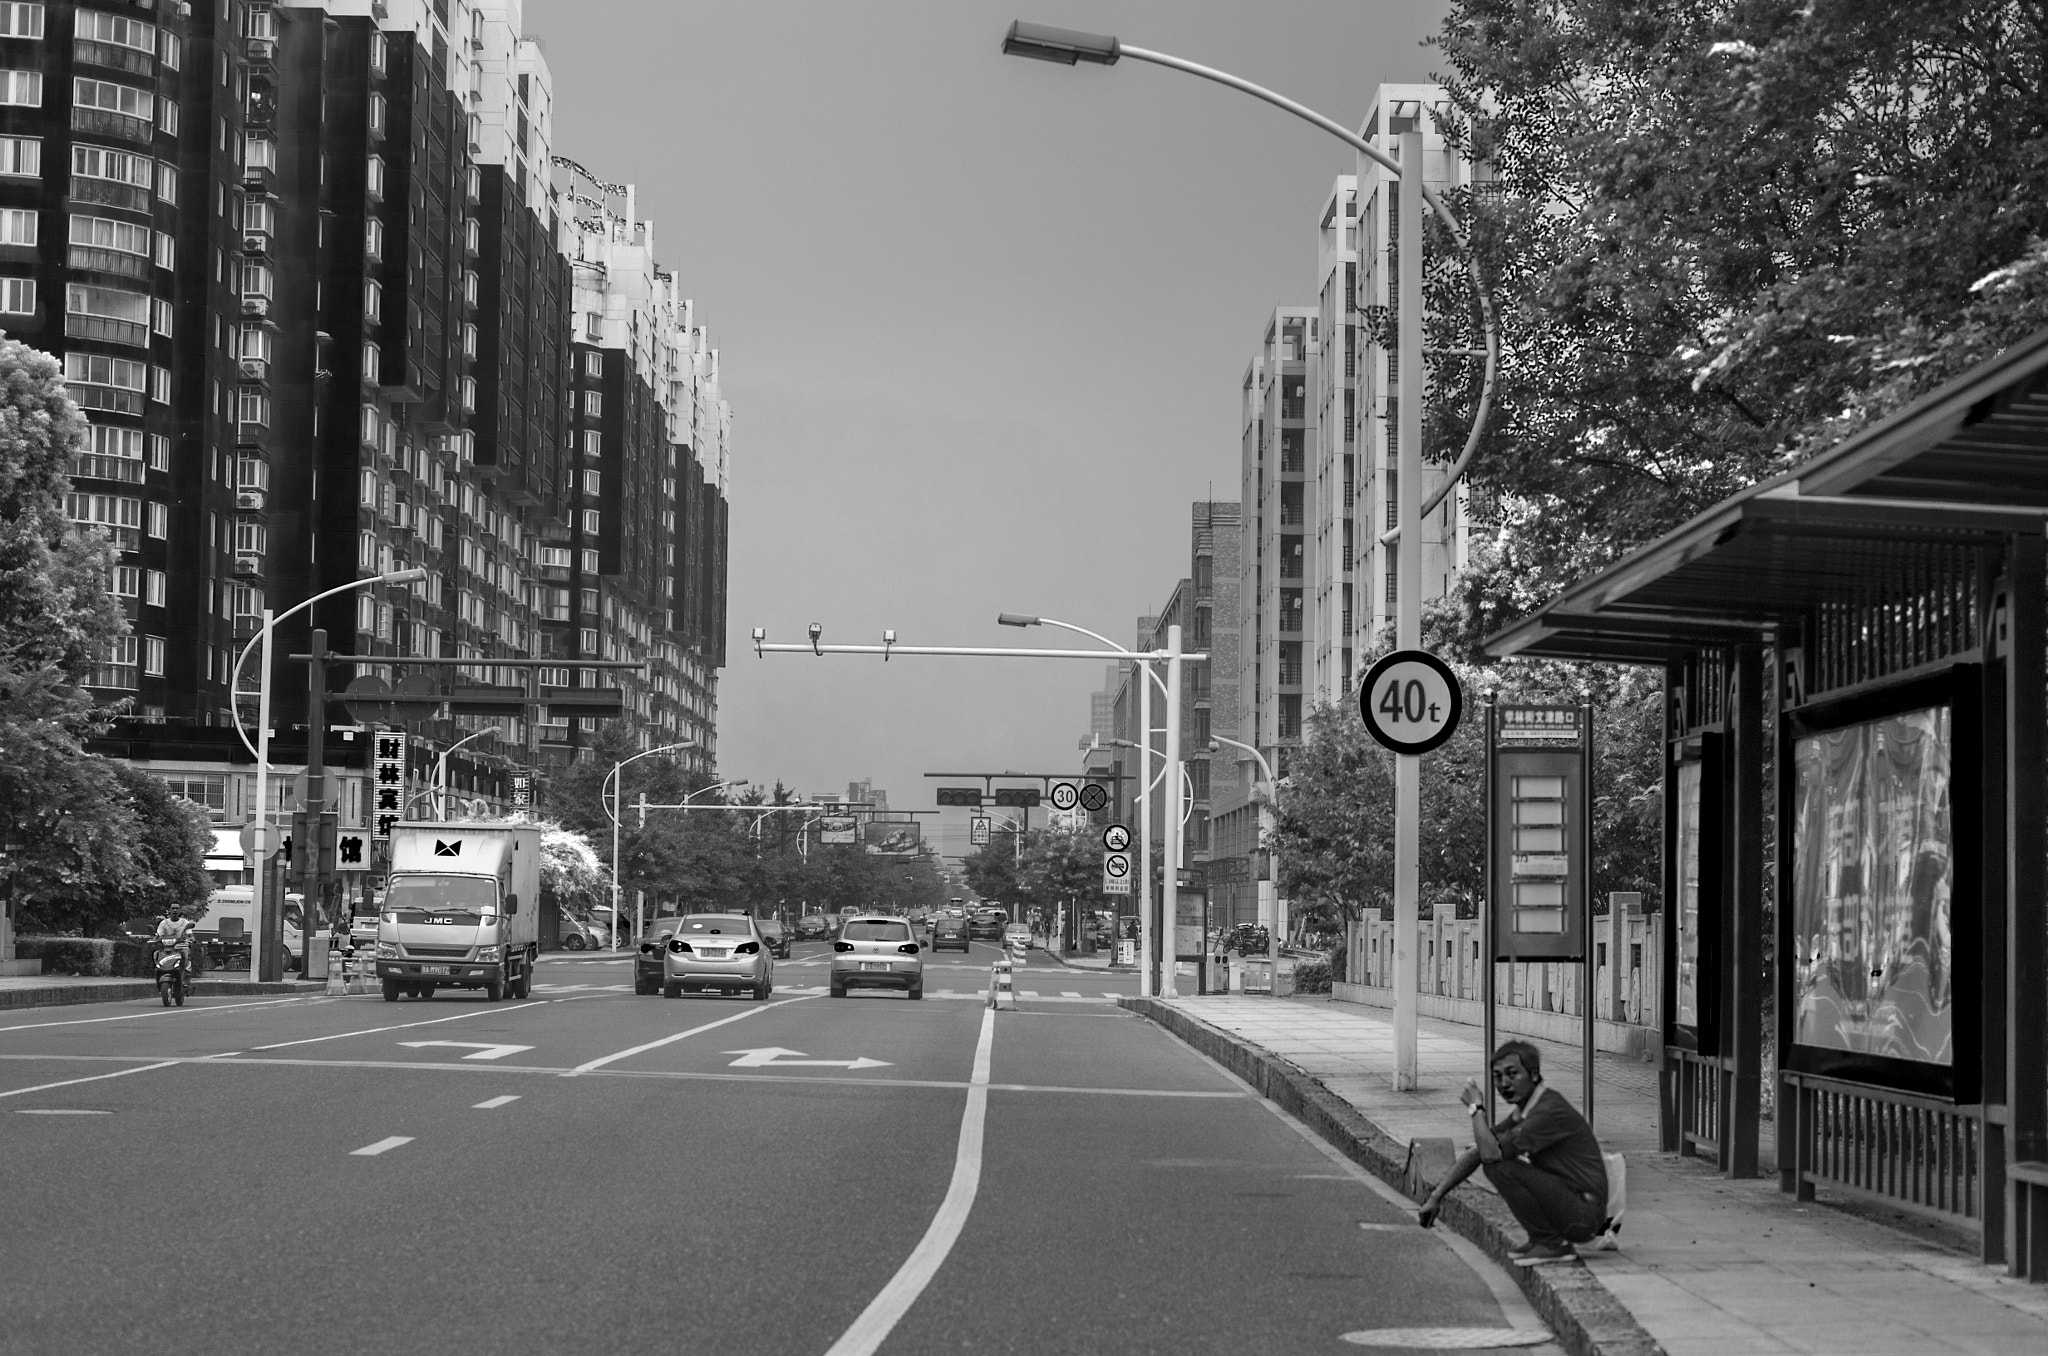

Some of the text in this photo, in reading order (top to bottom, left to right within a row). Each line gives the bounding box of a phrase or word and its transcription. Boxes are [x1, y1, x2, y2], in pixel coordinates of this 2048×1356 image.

[1379, 679, 1441, 723] 40t
[1057, 790, 1073, 803] 30
[424, 917, 453, 925] JMC
